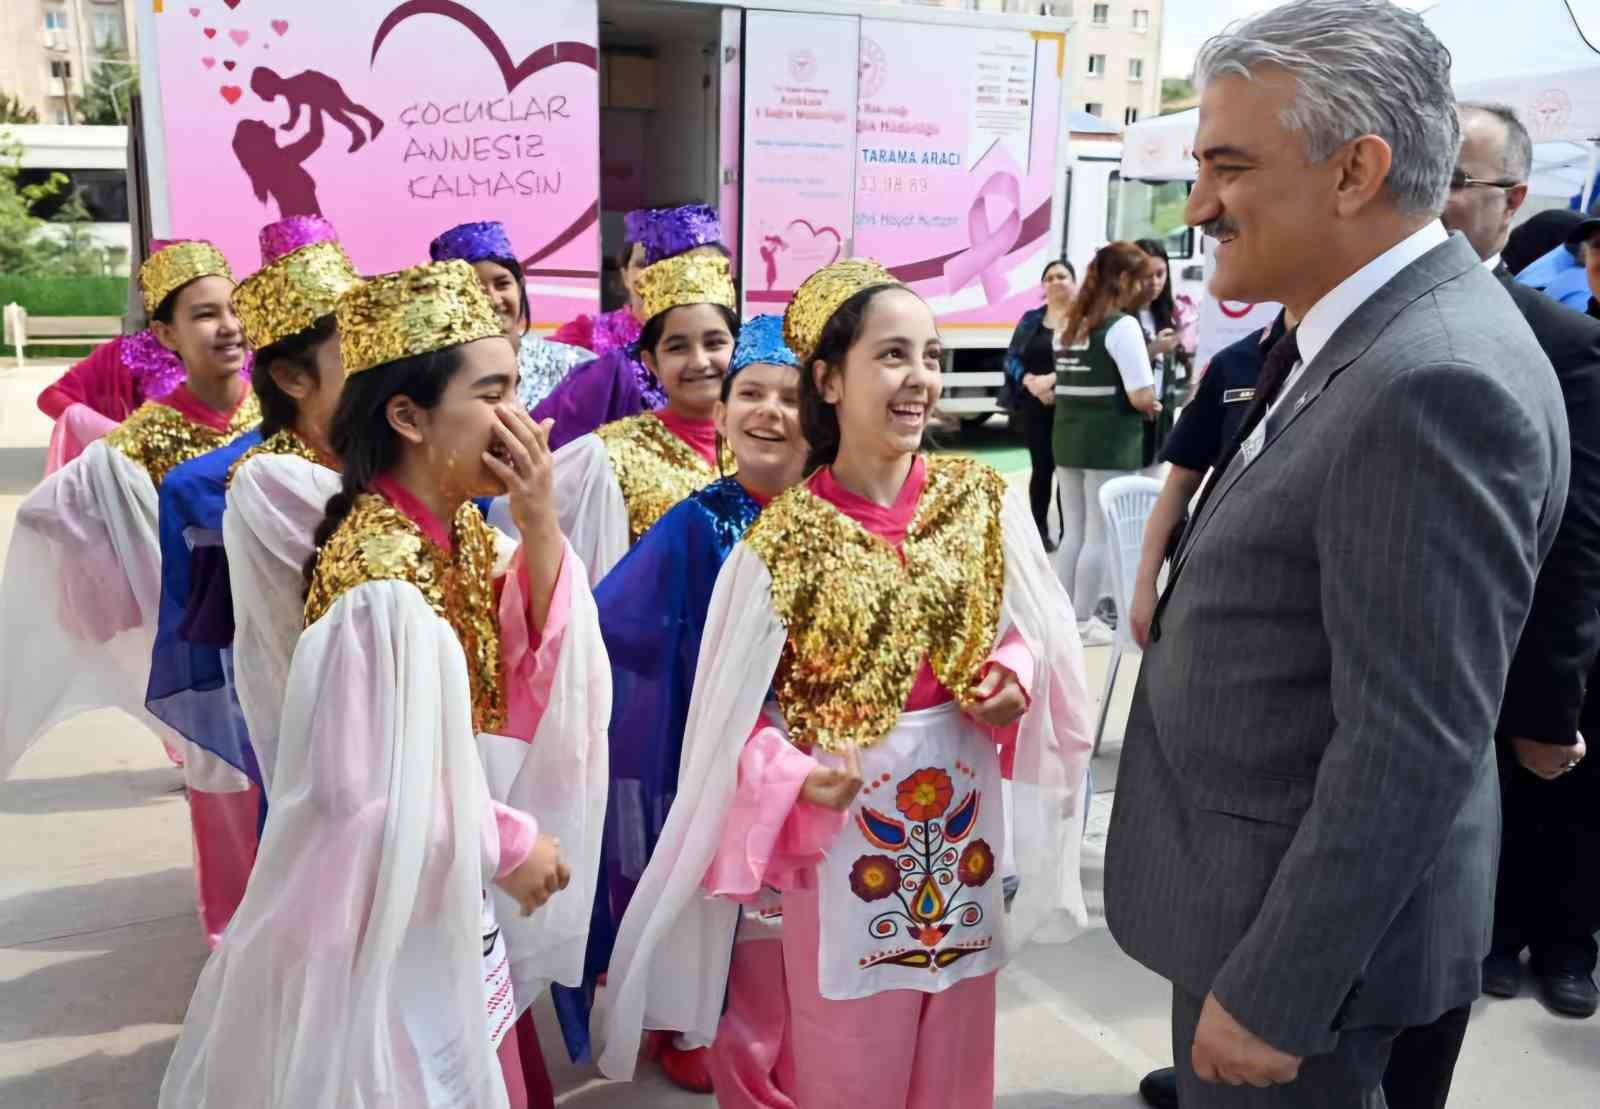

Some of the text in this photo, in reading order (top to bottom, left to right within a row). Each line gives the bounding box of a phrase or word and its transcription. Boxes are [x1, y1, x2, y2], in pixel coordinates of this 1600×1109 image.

[400, 95, 571, 129] ÇOCUKLAR
[862, 149, 960, 165] TARAMA ARACI
[408, 170, 561, 199] KALMASIN
